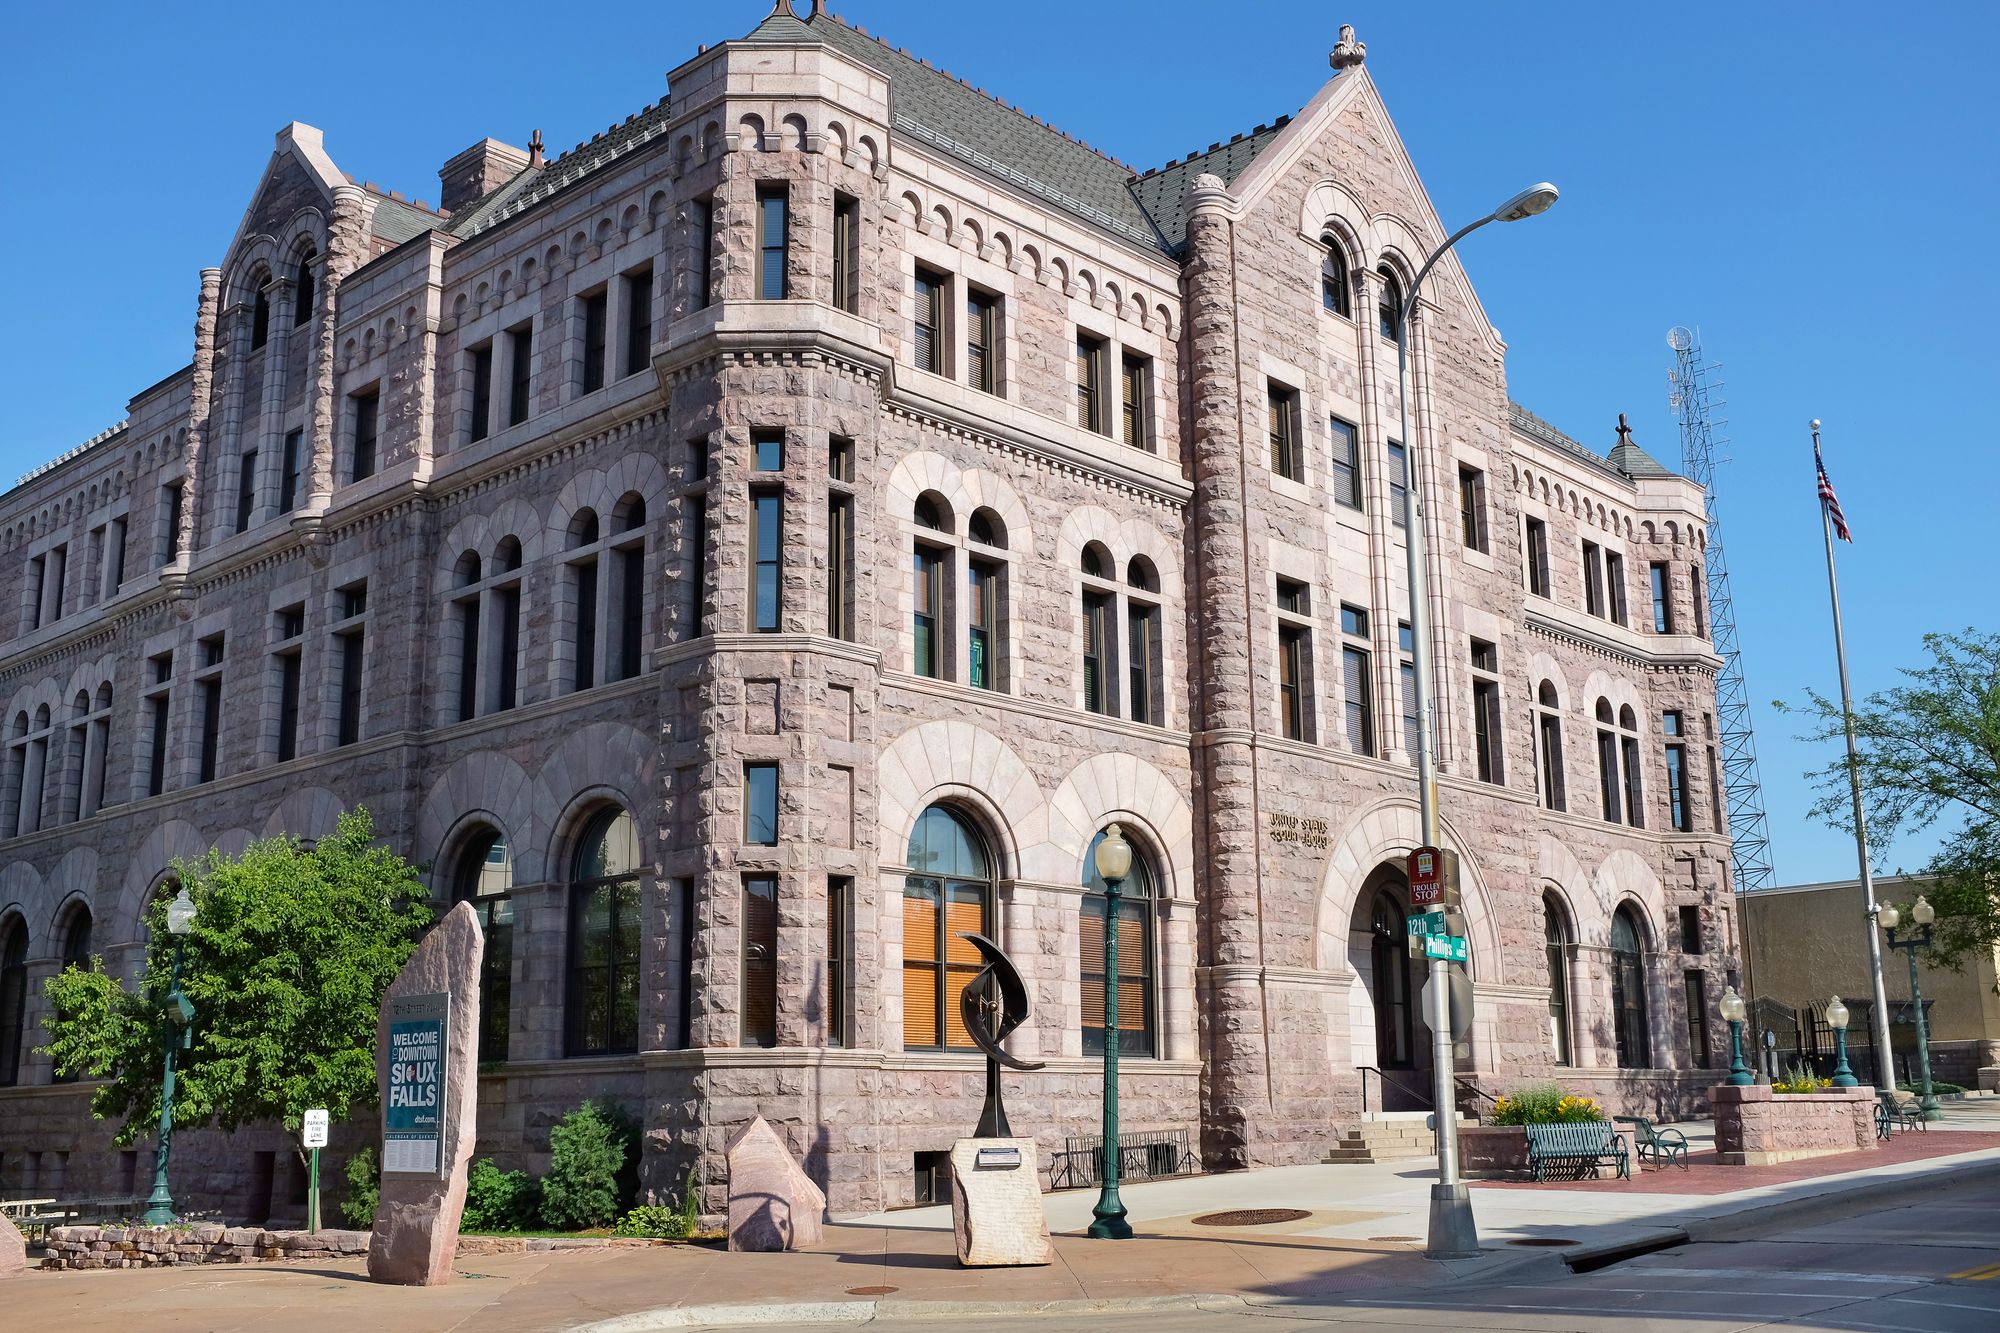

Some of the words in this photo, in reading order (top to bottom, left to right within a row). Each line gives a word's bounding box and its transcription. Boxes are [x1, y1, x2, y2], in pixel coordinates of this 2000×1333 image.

[1412, 882, 1440, 892] TROLLEY
[1415, 890, 1438, 901] STOP
[1408, 917, 1427, 935] 12th
[1427, 937, 1452, 959] Phillips
[393, 1031, 438, 1046] WELCOME
[398, 1045, 438, 1062] DOWNTOWN
[391, 1061, 437, 1085] SIOUX
[389, 1084, 436, 1108] FALLS
